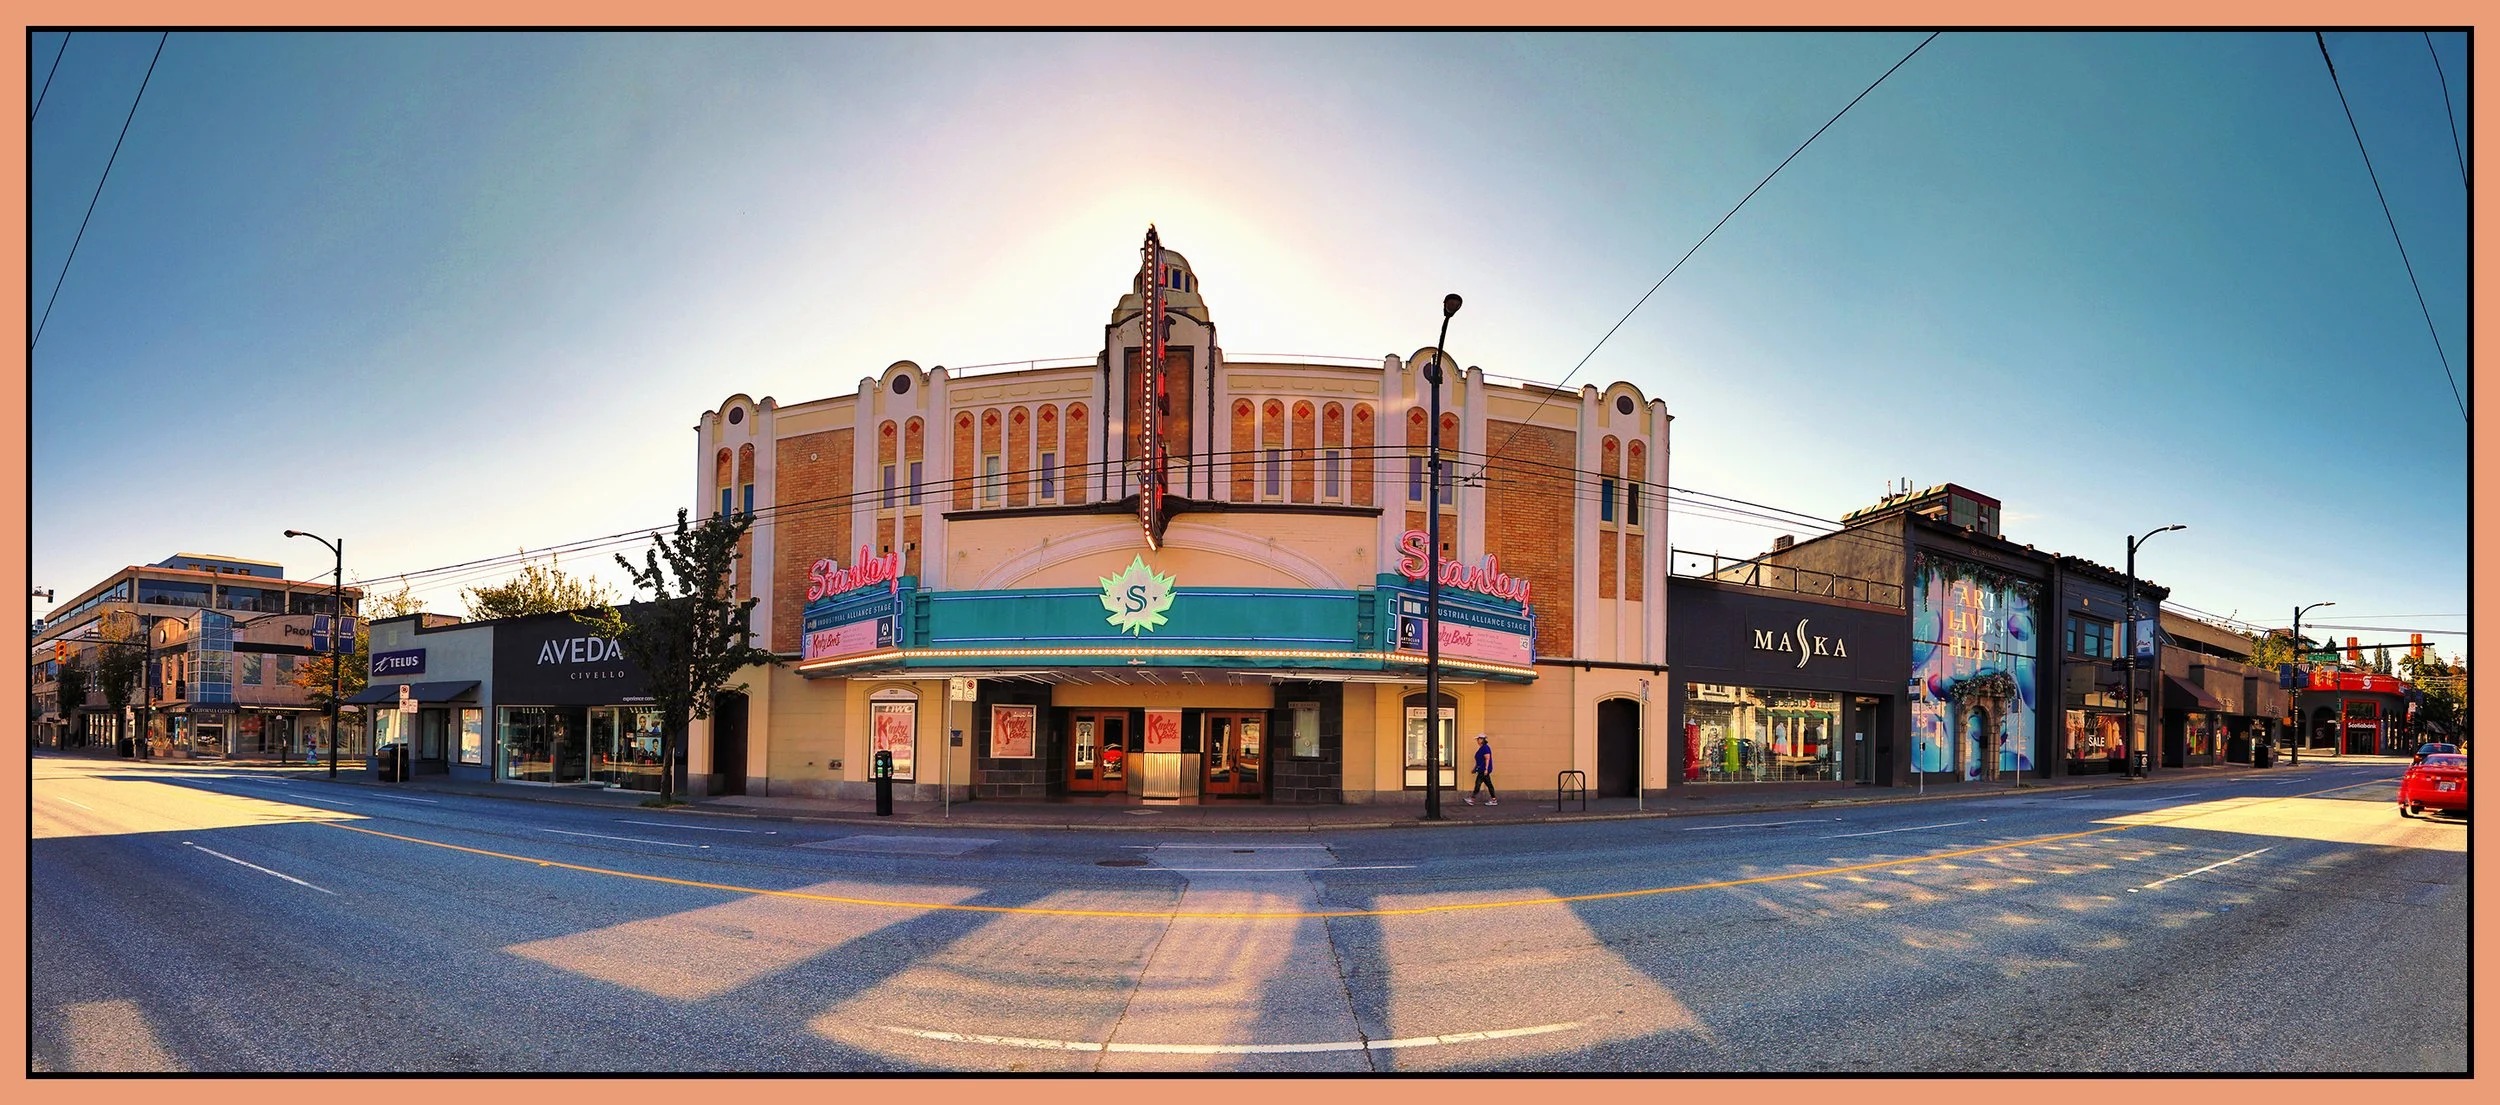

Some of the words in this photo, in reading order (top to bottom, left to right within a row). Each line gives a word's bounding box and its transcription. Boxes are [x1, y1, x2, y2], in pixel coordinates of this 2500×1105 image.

[806, 544, 900, 602] Stanley
[1397, 529, 1531, 617] Stanley
[1125, 585, 1147, 616] S
[1957, 584, 1996, 613] ART
[818, 614, 846, 626] INDUSTRIAL
[847, 607, 872, 619] ALLIANCE
[874, 602, 892, 614] STAGE
[1424, 606, 1468, 621] IUSTRIAL
[1471, 614, 1504, 627] ALLIANCE
[1506, 620, 1526, 631] STAGE
[1947, 608, 2004, 639] LIVES
[537, 637, 624, 665] AVEDA
[1451, 632, 1473, 646] Boots
[1753, 618, 1848, 669] MASKA
[1947, 635, 2003, 663] HERE
[390, 656, 418, 668] TELUS
[570, 671, 625, 680] CIVELLO
[878, 715, 908, 751] Kinky
[888, 736, 910, 745] Boots
[996, 710, 1027, 745] Kinky
[1010, 729, 1030, 740] Boots
[1148, 714, 1177, 745] Kinky
[1160, 730, 1180, 740] Boots
[2088, 736, 2105, 748] SALE
